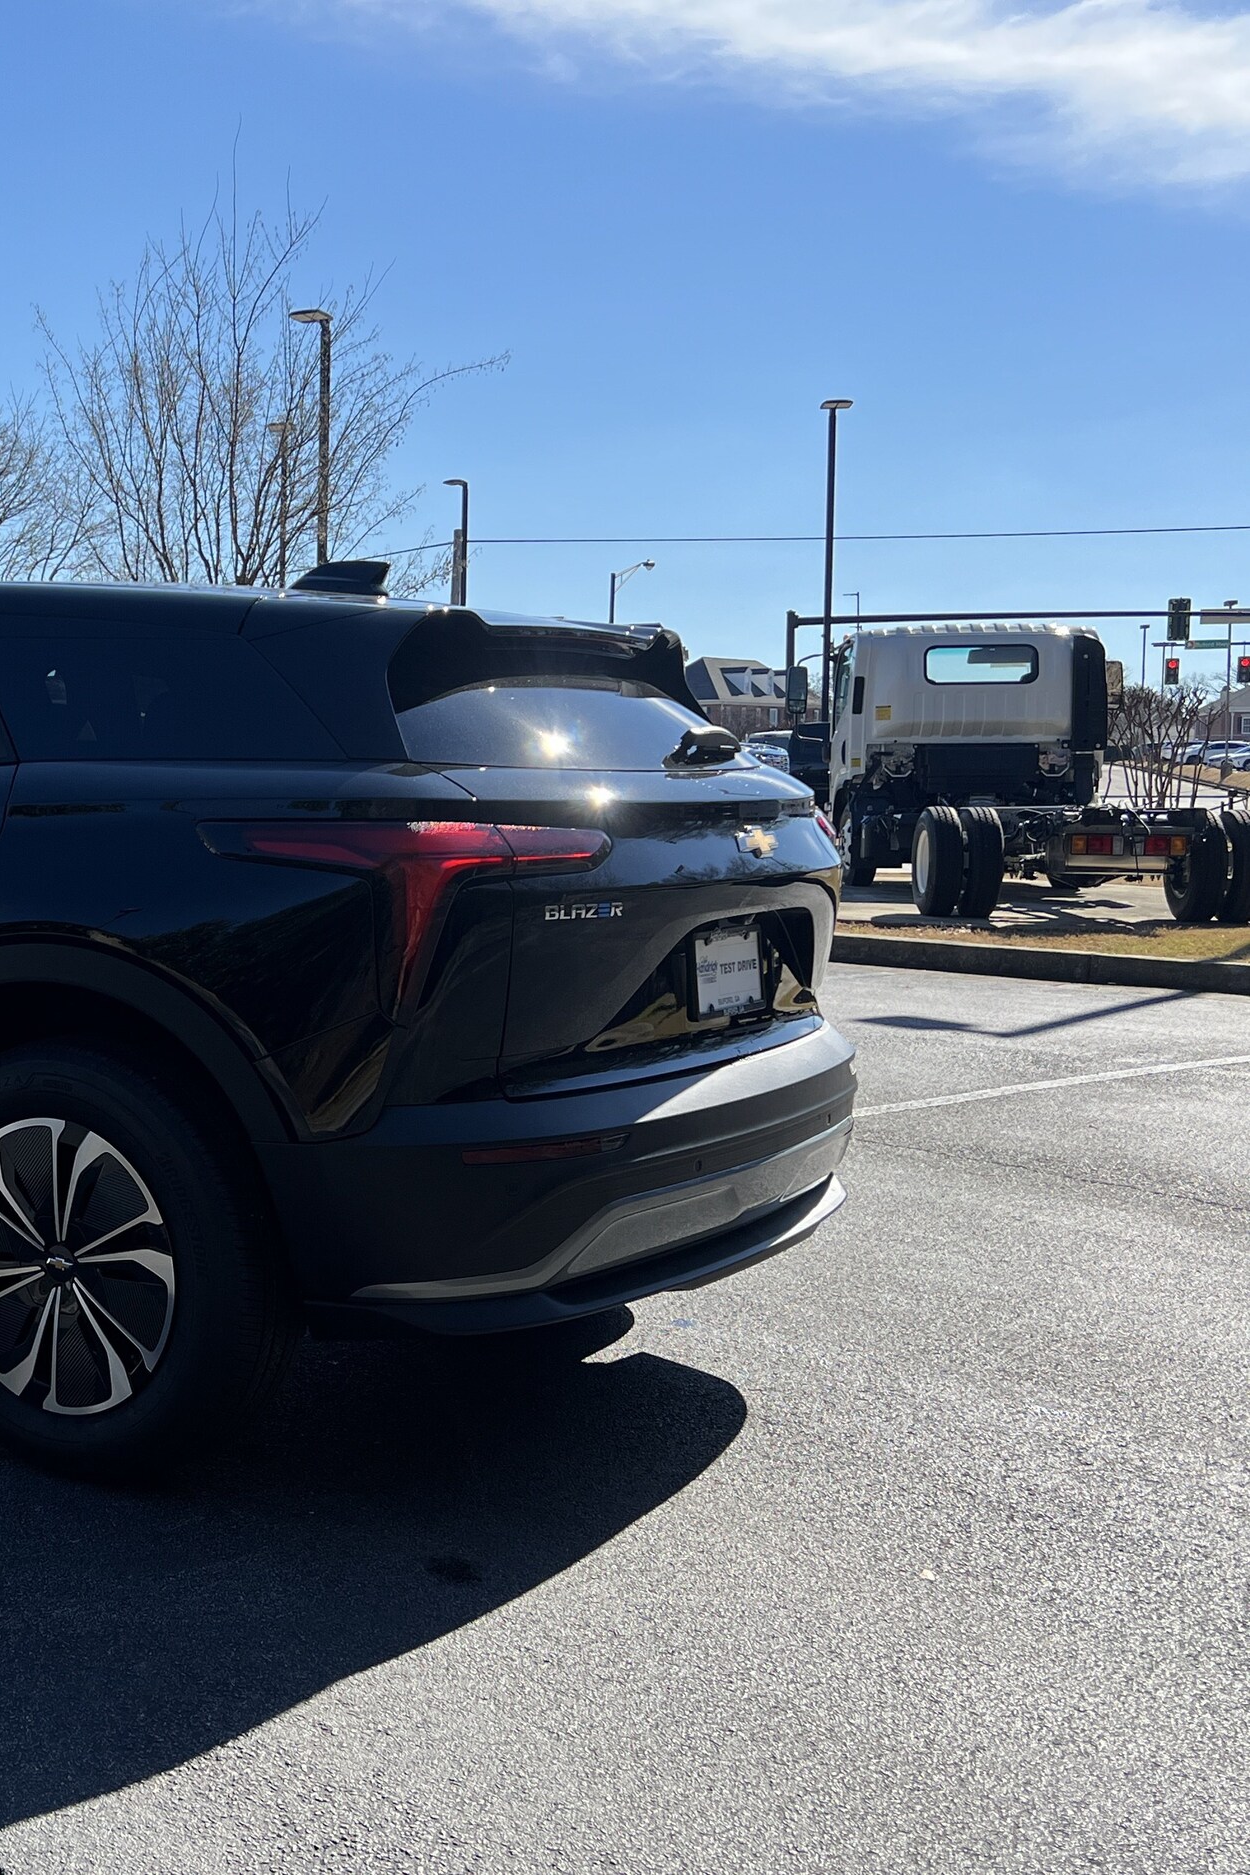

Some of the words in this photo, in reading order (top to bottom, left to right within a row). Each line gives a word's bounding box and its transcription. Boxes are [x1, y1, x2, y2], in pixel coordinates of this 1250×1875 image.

[544, 902, 623, 921] BLAZER
[719, 962, 736, 975] TEST
[737, 958, 757, 972] DRIVE
